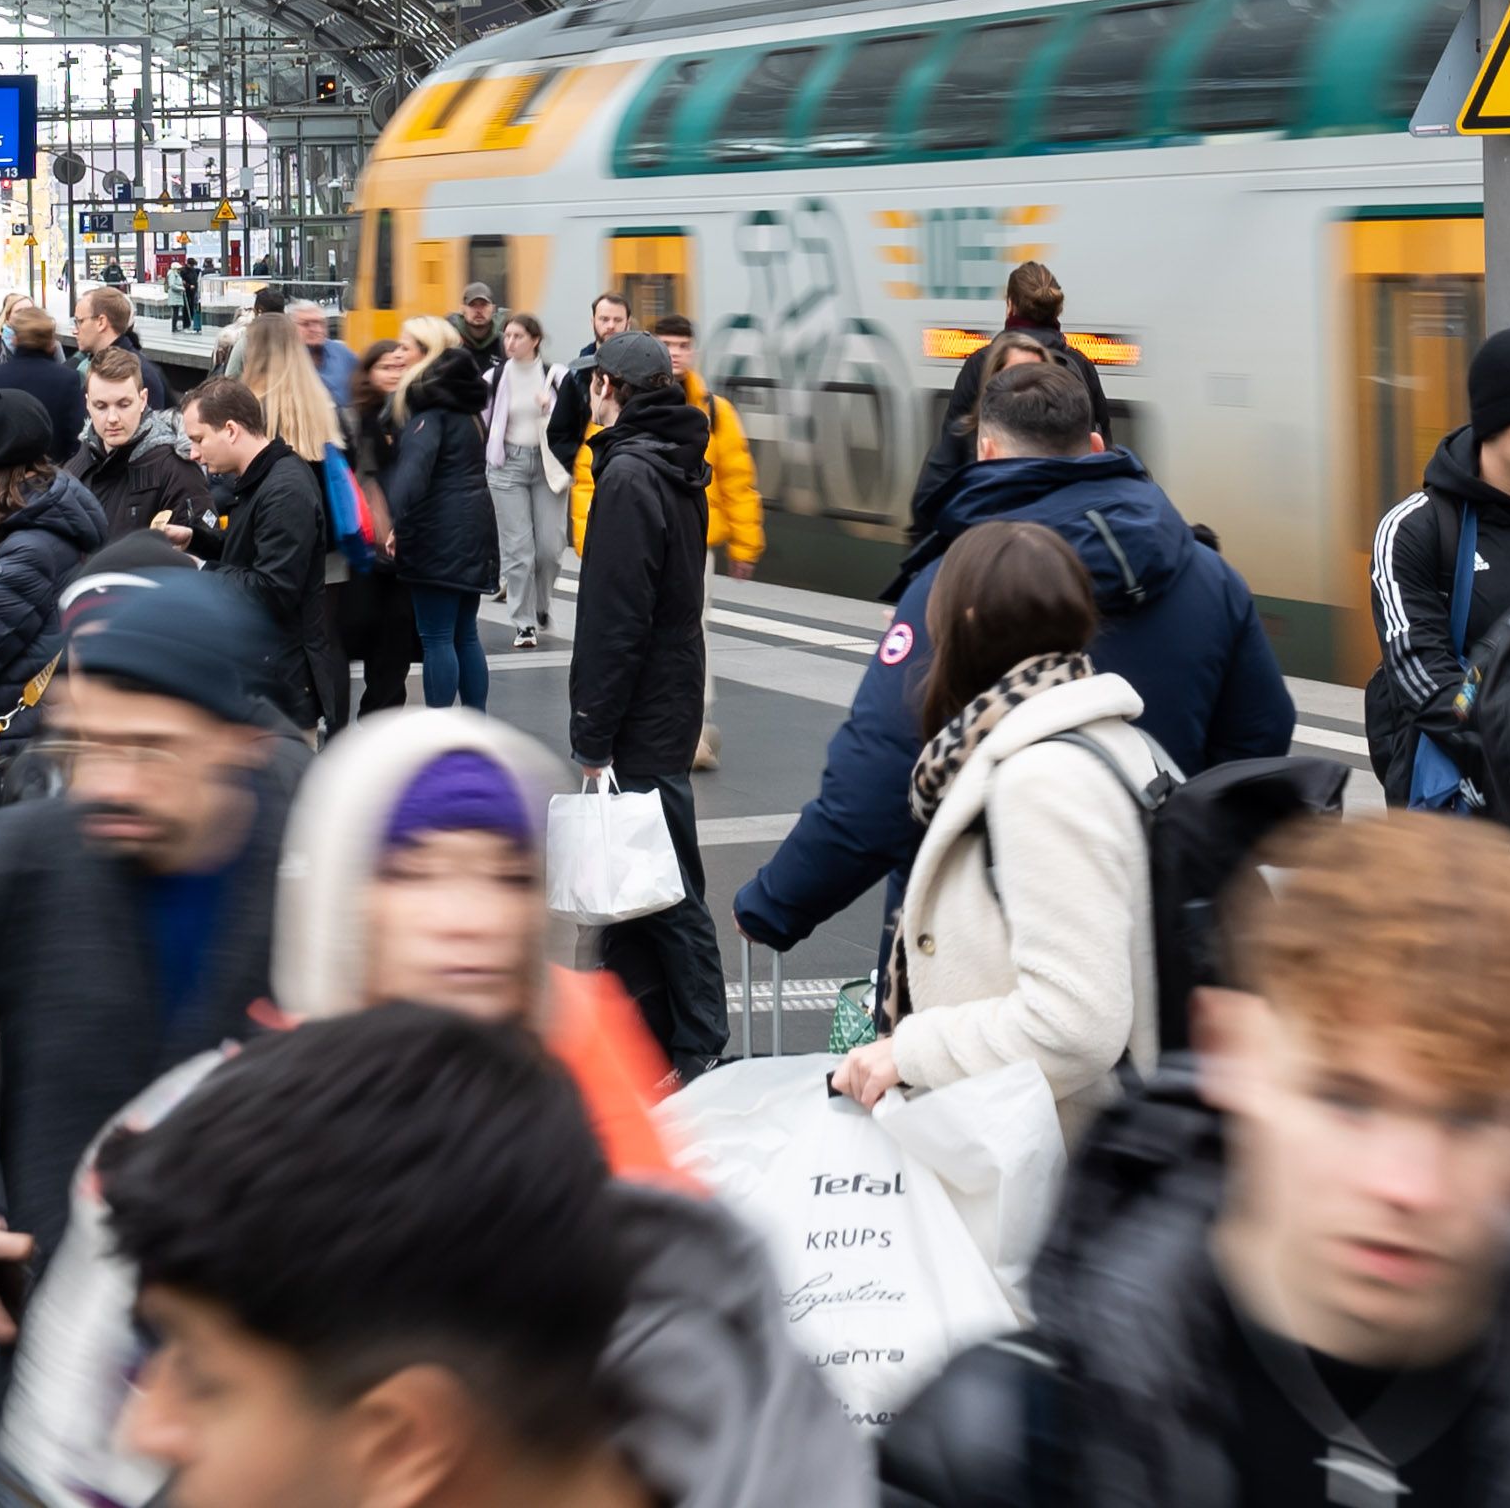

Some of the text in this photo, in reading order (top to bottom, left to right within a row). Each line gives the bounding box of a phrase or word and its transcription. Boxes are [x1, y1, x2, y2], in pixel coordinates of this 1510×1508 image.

[4, 168, 19, 177] 13
[114, 184, 124, 198] F
[13, 223, 22, 235] G
[93, 216, 108, 228] 12
[810, 1172, 906, 1196] Tefal
[806, 1228, 892, 1251] KRUPS
[779, 1271, 906, 1323] Lagostina
